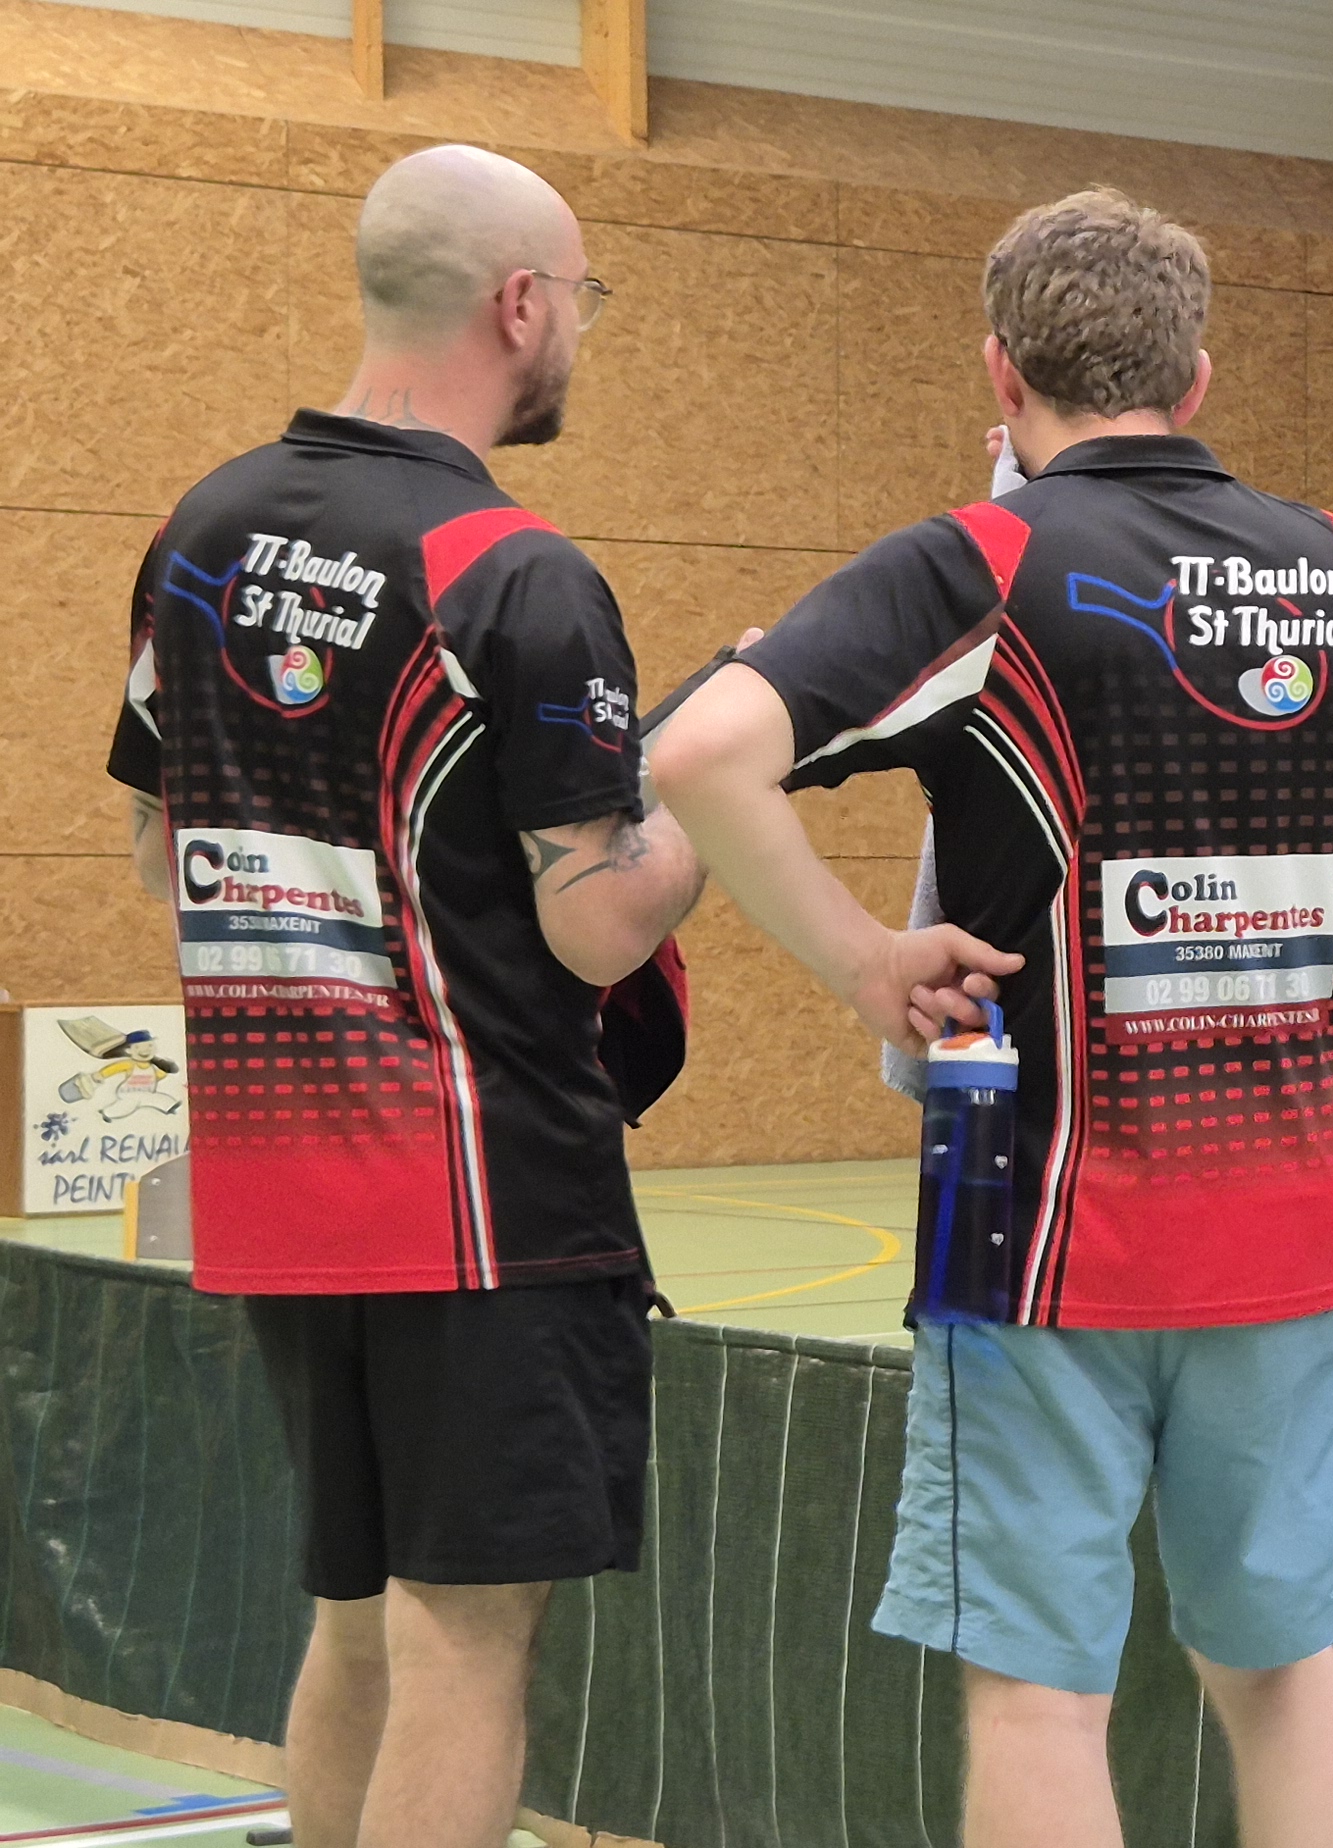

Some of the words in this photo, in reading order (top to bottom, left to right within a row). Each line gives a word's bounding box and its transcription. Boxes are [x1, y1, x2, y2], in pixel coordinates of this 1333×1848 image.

[246, 532, 387, 609] TT-Baulon
[235, 584, 275, 628] St
[271, 590, 377, 650] Thurial
[1187, 604, 1229, 646] St
[1125, 900, 1324, 939] Charpentes
[197, 945, 224, 972] 02
[230, 944, 262, 972] 99
[285, 946, 317, 973] 71
[329, 951, 363, 980] 30
[1175, 945, 1224, 961] 35380
[1146, 978, 1174, 1006] 02
[1179, 976, 1210, 1003] 99
[1217, 975, 1249, 1001] 06
[1254, 973, 1278, 999] 71
[53, 1172, 136, 1204] PEINT
